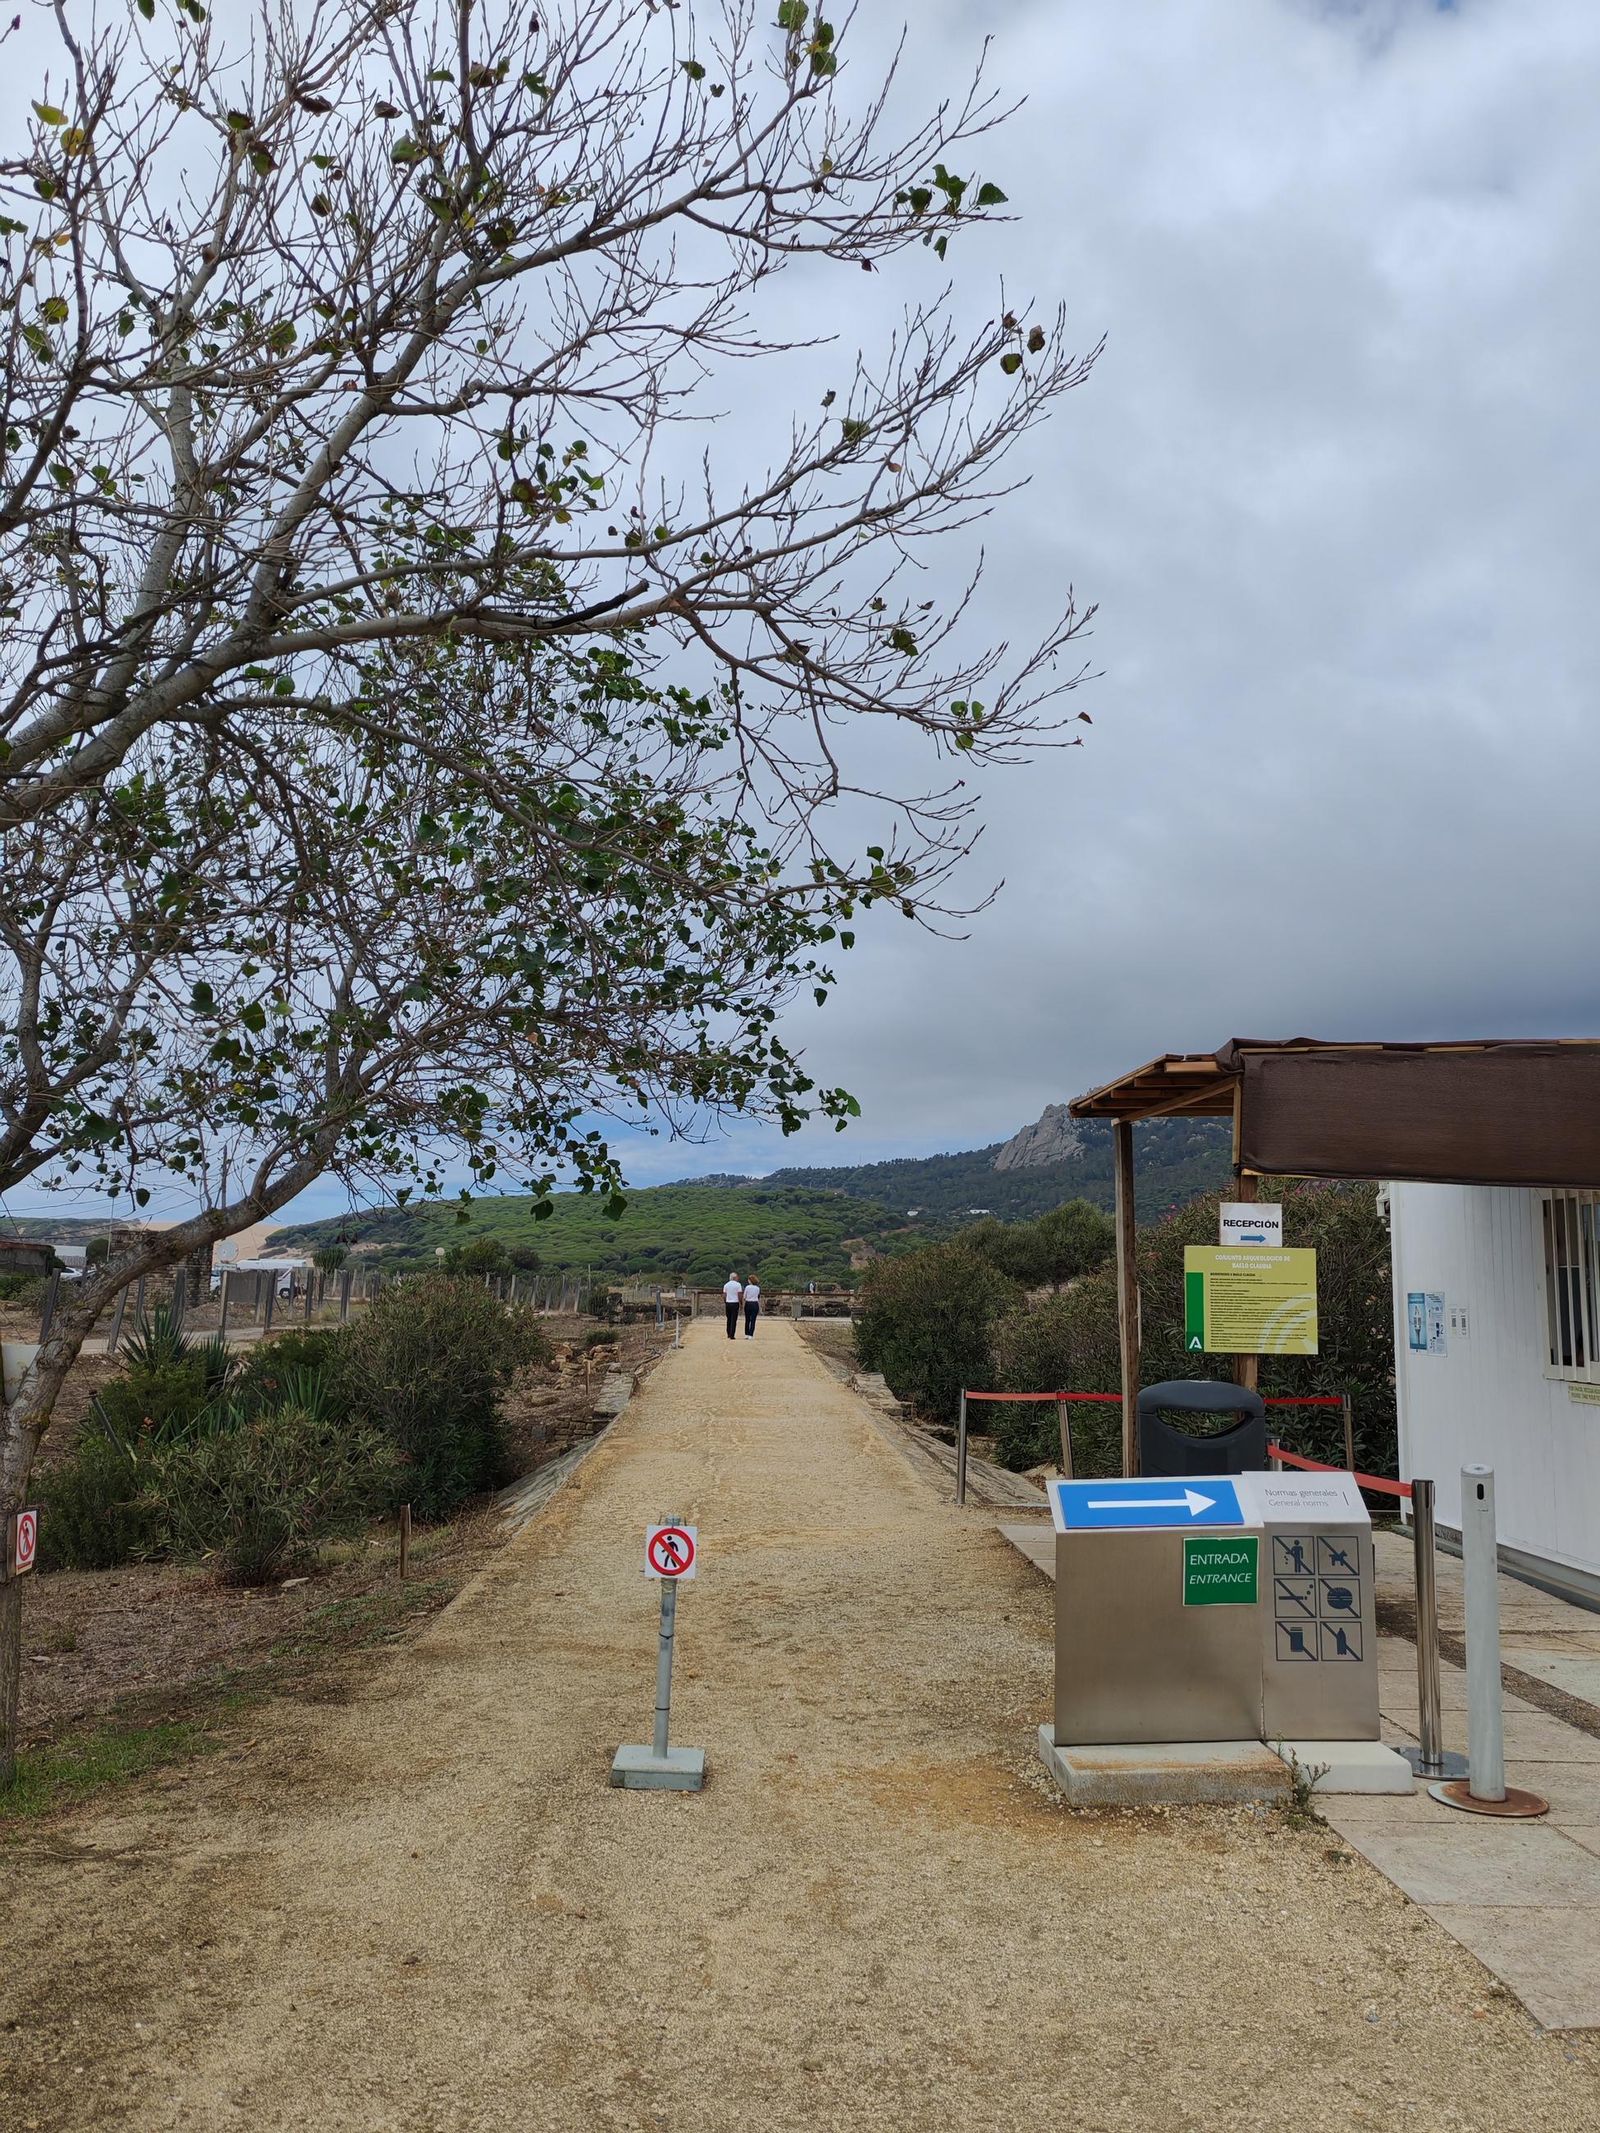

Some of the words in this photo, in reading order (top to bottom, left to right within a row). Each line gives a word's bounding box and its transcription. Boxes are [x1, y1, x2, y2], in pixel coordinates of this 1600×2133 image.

[1223, 1219, 1280, 1229] RECEPCIÓN
[1264, 1488, 1298, 1497] Normas
[1298, 1488, 1338, 1499] generales
[1268, 1499, 1301, 1507] General
[1190, 1552, 1250, 1566] ENTRADA
[1189, 1572, 1253, 1585] ENTRANCE
